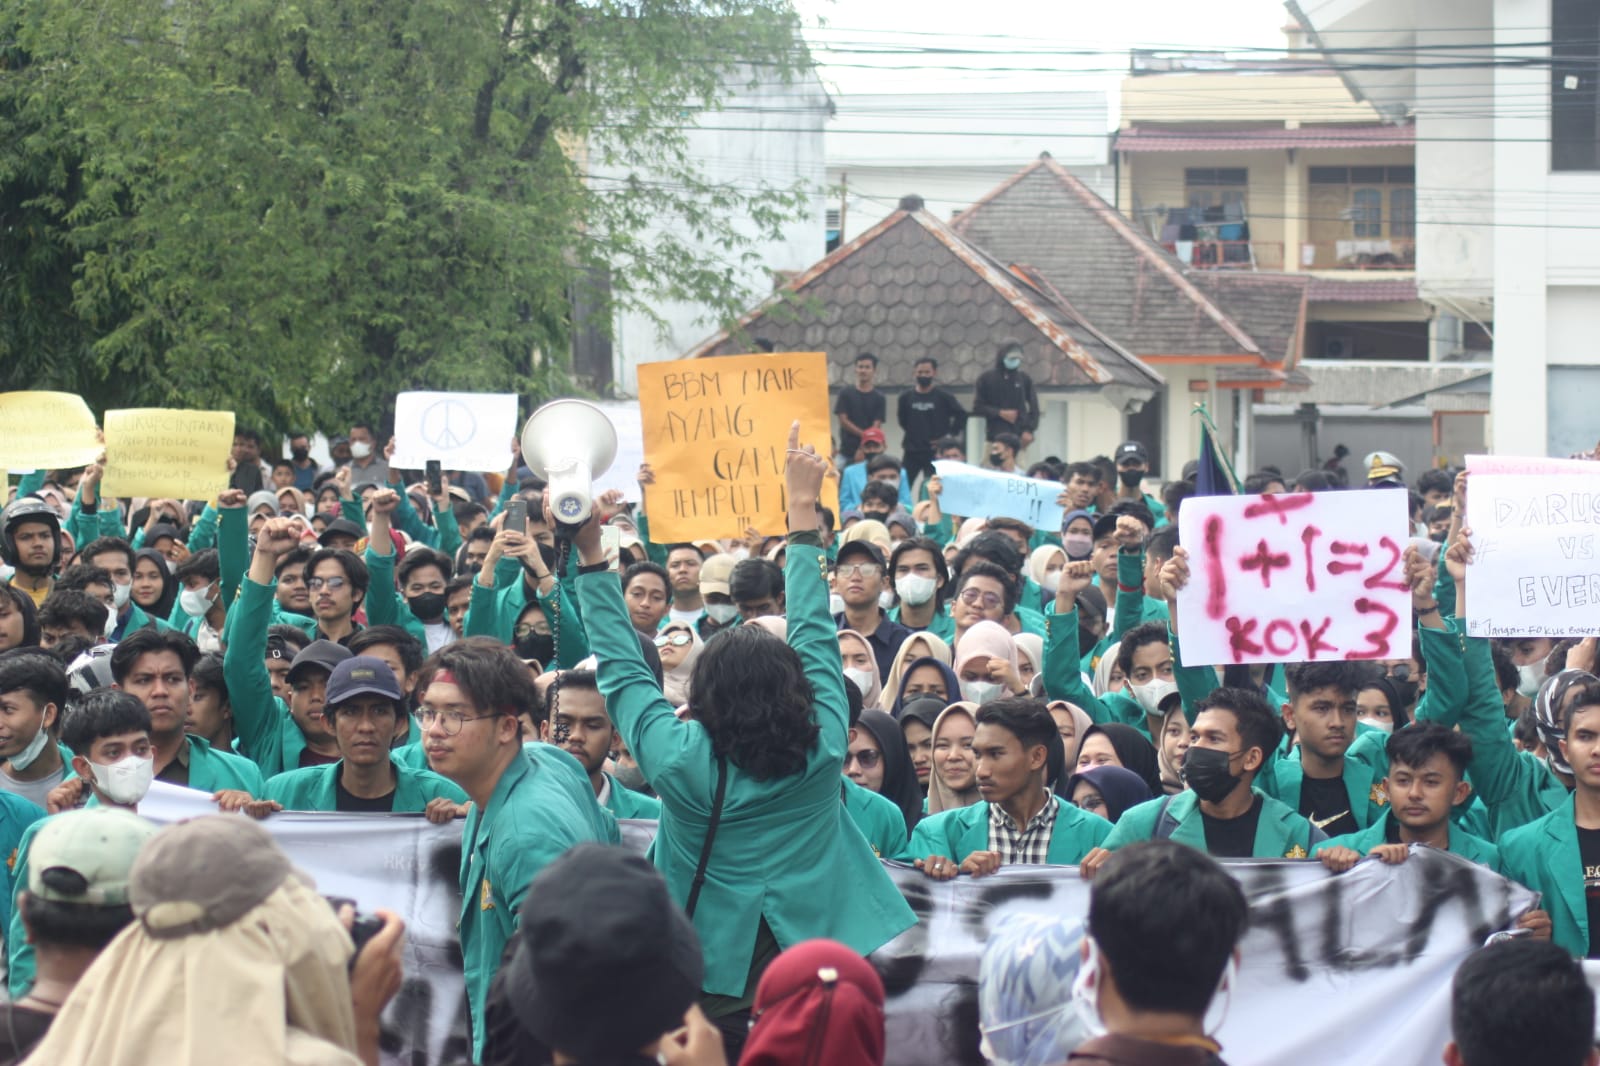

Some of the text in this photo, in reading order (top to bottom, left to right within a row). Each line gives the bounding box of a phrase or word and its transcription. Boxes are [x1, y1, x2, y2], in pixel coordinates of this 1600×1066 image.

[664, 368, 808, 400] BBM NAIK
[661, 402, 754, 442] AYANG
[664, 483, 768, 518] JEMPUT
[1007, 478, 1038, 497] BBM
[1225, 597, 1399, 664] KOK 3
